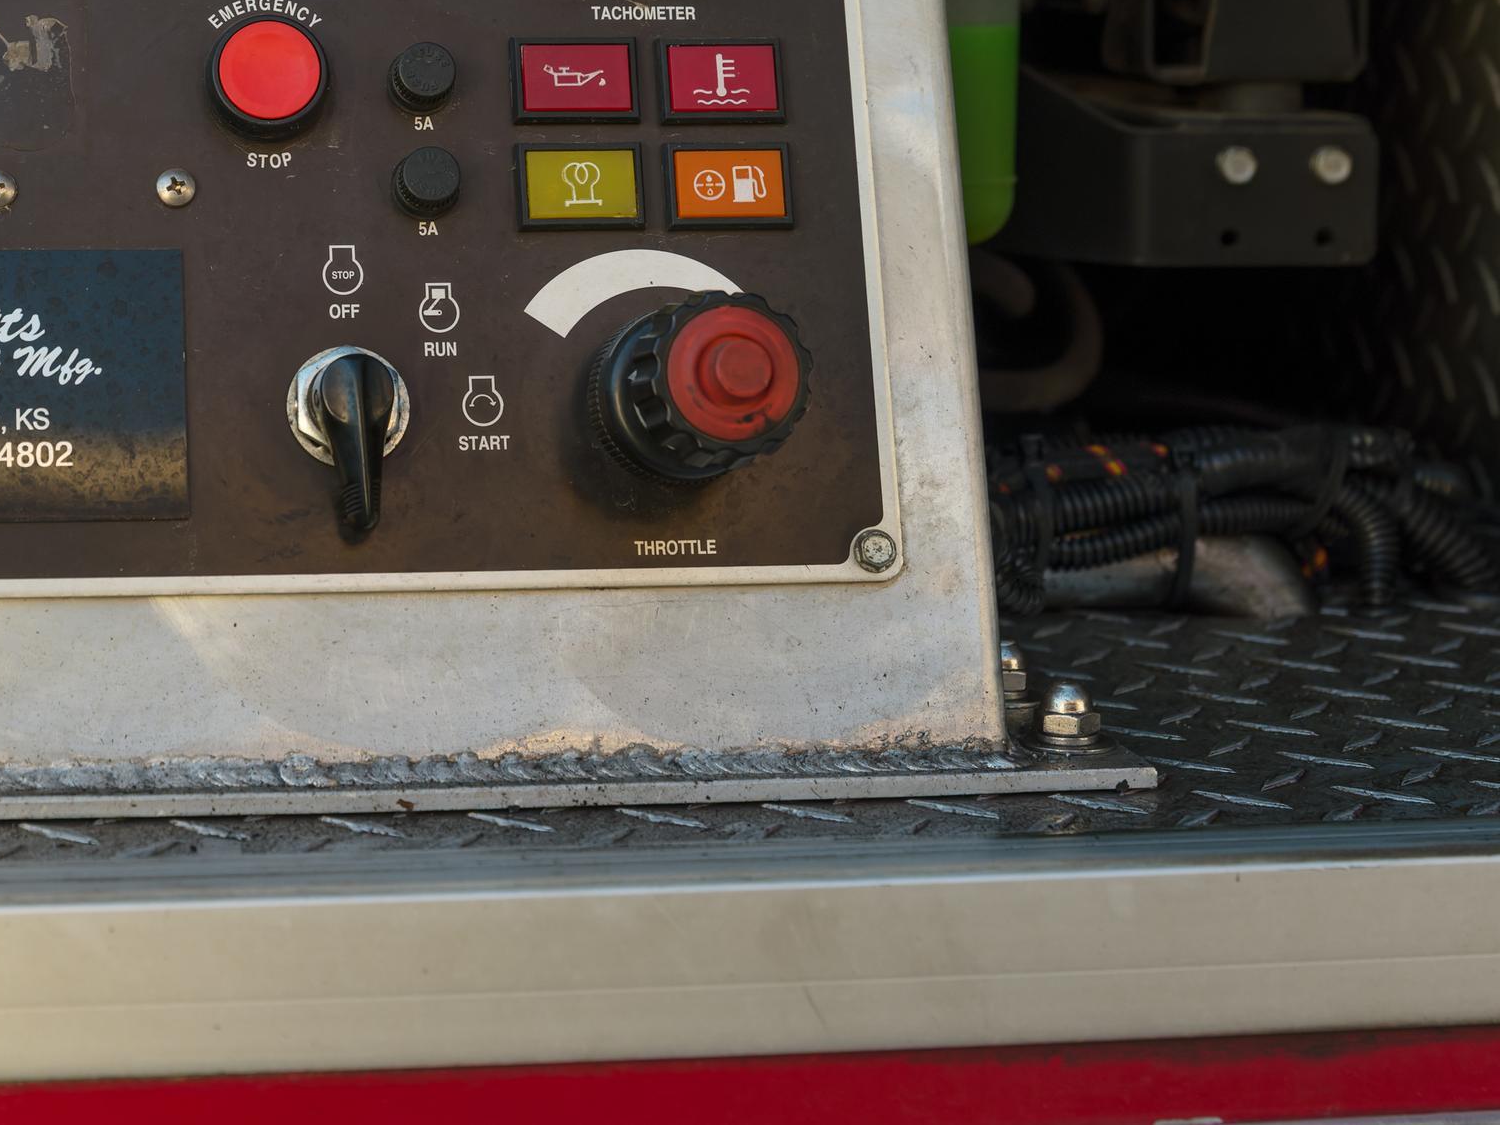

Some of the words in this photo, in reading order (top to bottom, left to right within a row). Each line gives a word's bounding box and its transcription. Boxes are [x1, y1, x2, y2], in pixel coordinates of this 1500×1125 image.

[591, 5, 695, 21] TACHOMETER
[414, 116, 433, 131] 5A
[246, 151, 292, 170] STOP
[418, 221, 439, 237] 5A
[331, 271, 355, 280] STOP
[329, 304, 360, 319] OFF
[424, 342, 457, 357] RUN
[13, 346, 103, 385] Mfg.
[14, 408, 50, 431] KS
[458, 435, 510, 451] START
[634, 539, 716, 557] THROTTLE
